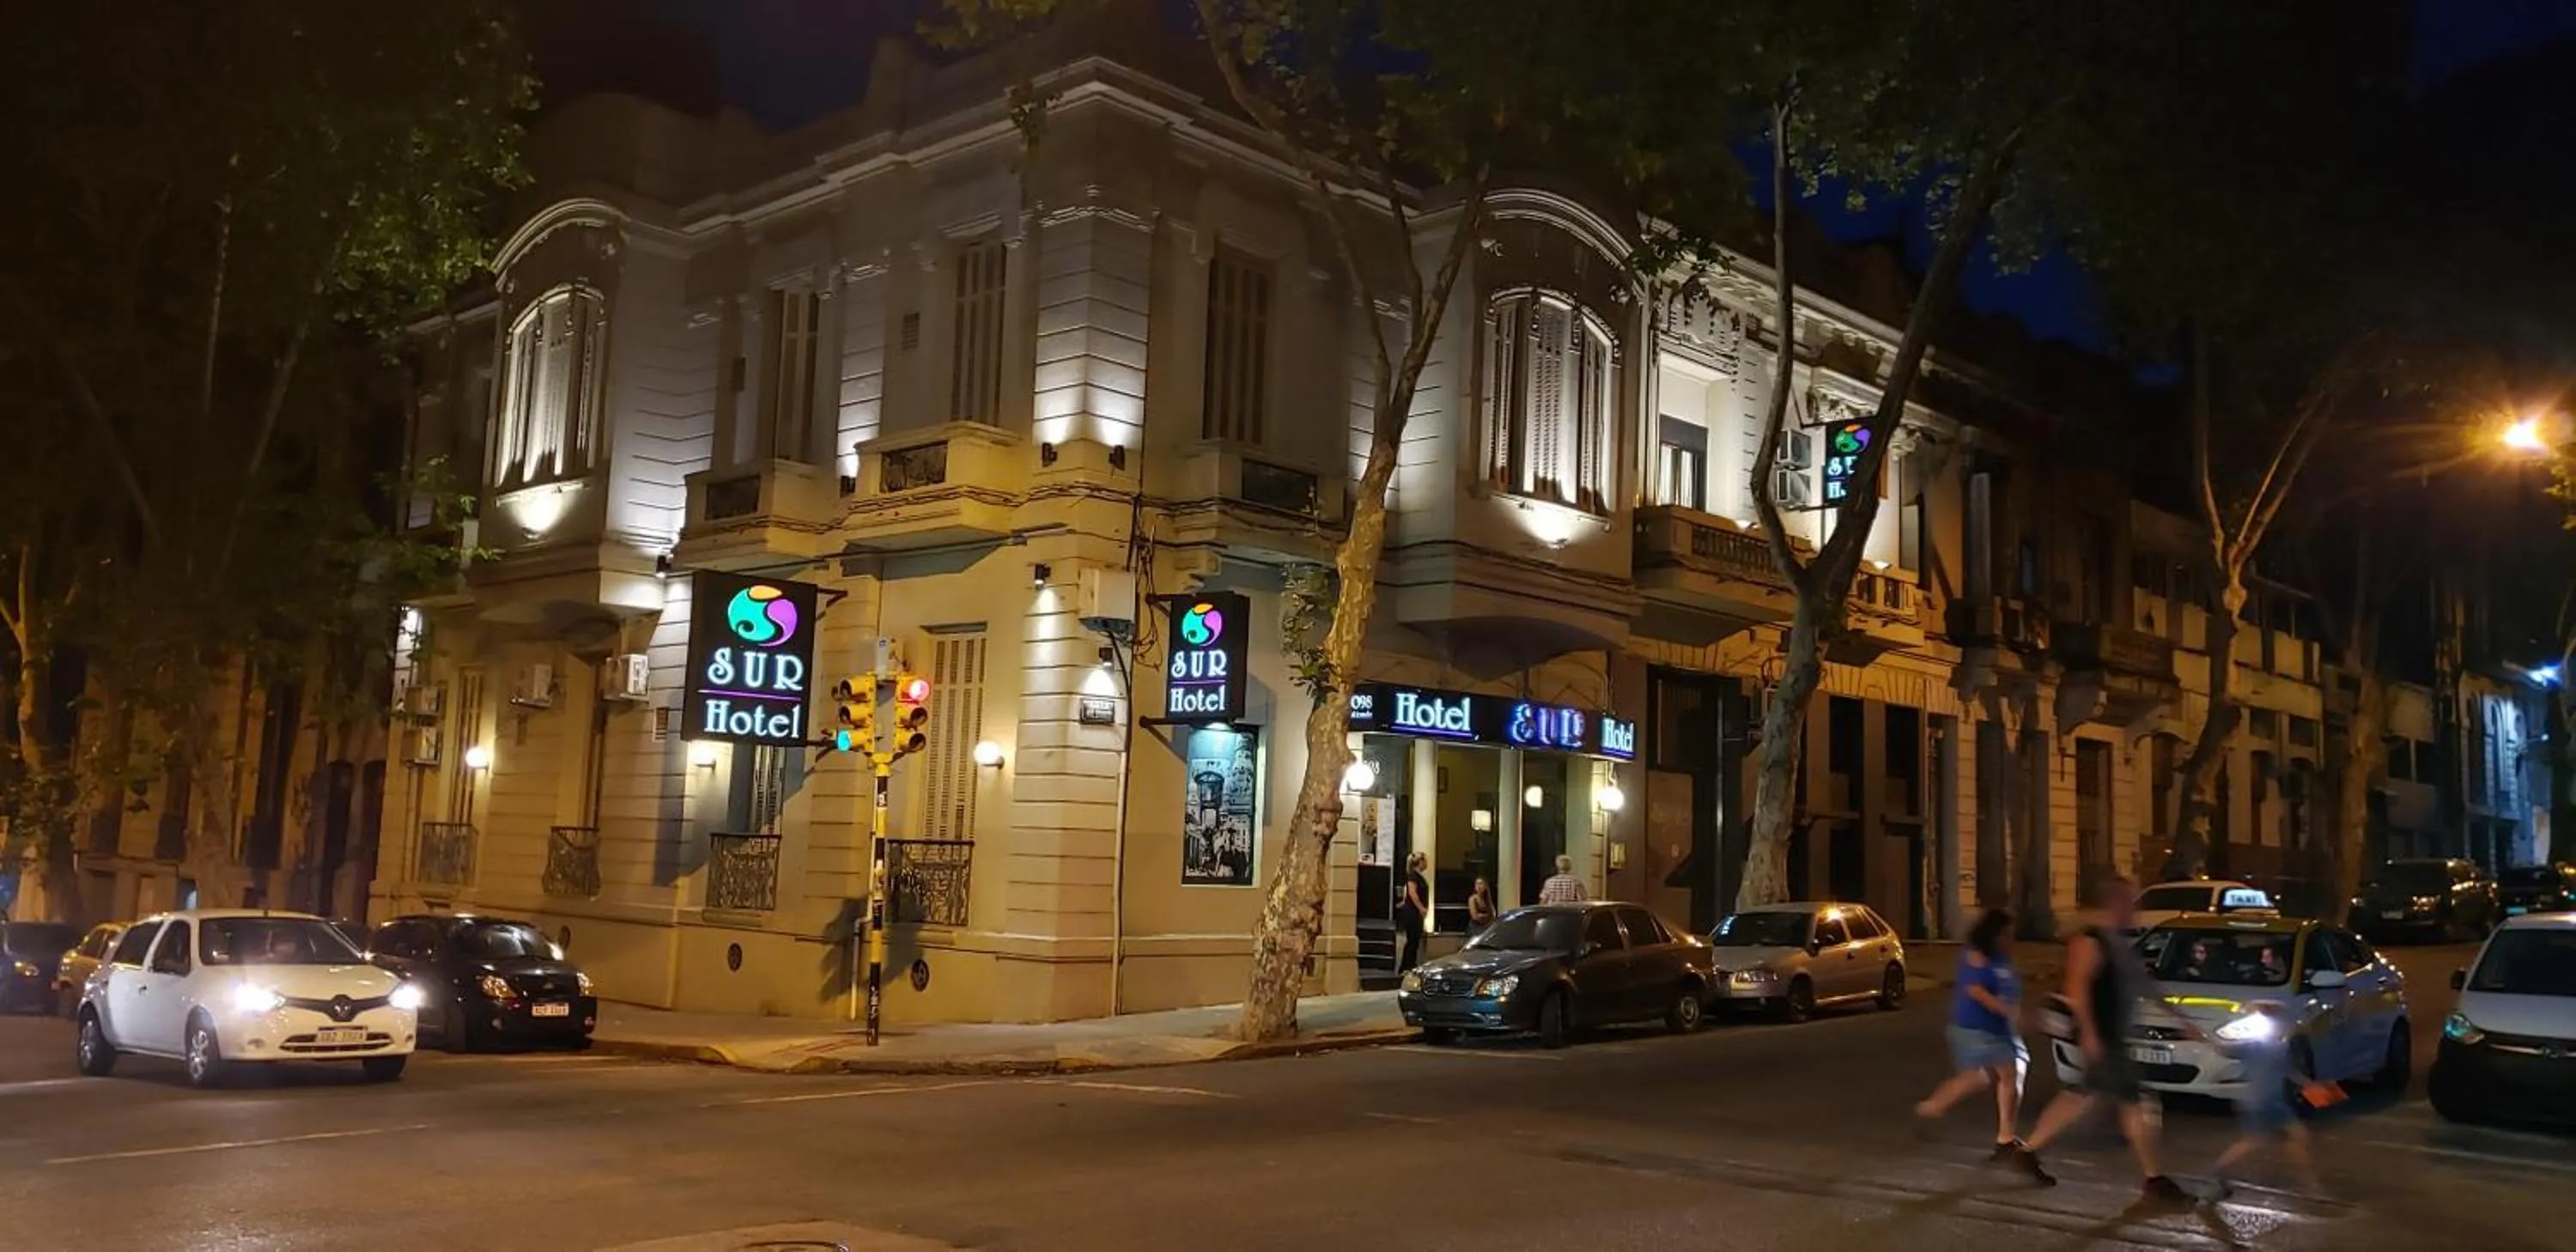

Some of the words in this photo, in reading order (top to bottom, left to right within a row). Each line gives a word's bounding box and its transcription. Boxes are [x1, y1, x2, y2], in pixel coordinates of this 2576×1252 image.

[707, 647, 804, 690] SUR
[1170, 649, 1227, 678] SUR
[1170, 685, 1226, 713] Hotel
[704, 699, 801, 738] Hotel
[1395, 692, 1471, 732] Hotel
[1511, 702, 1586, 748] SUR
[1602, 716, 1635, 753] Hotel
